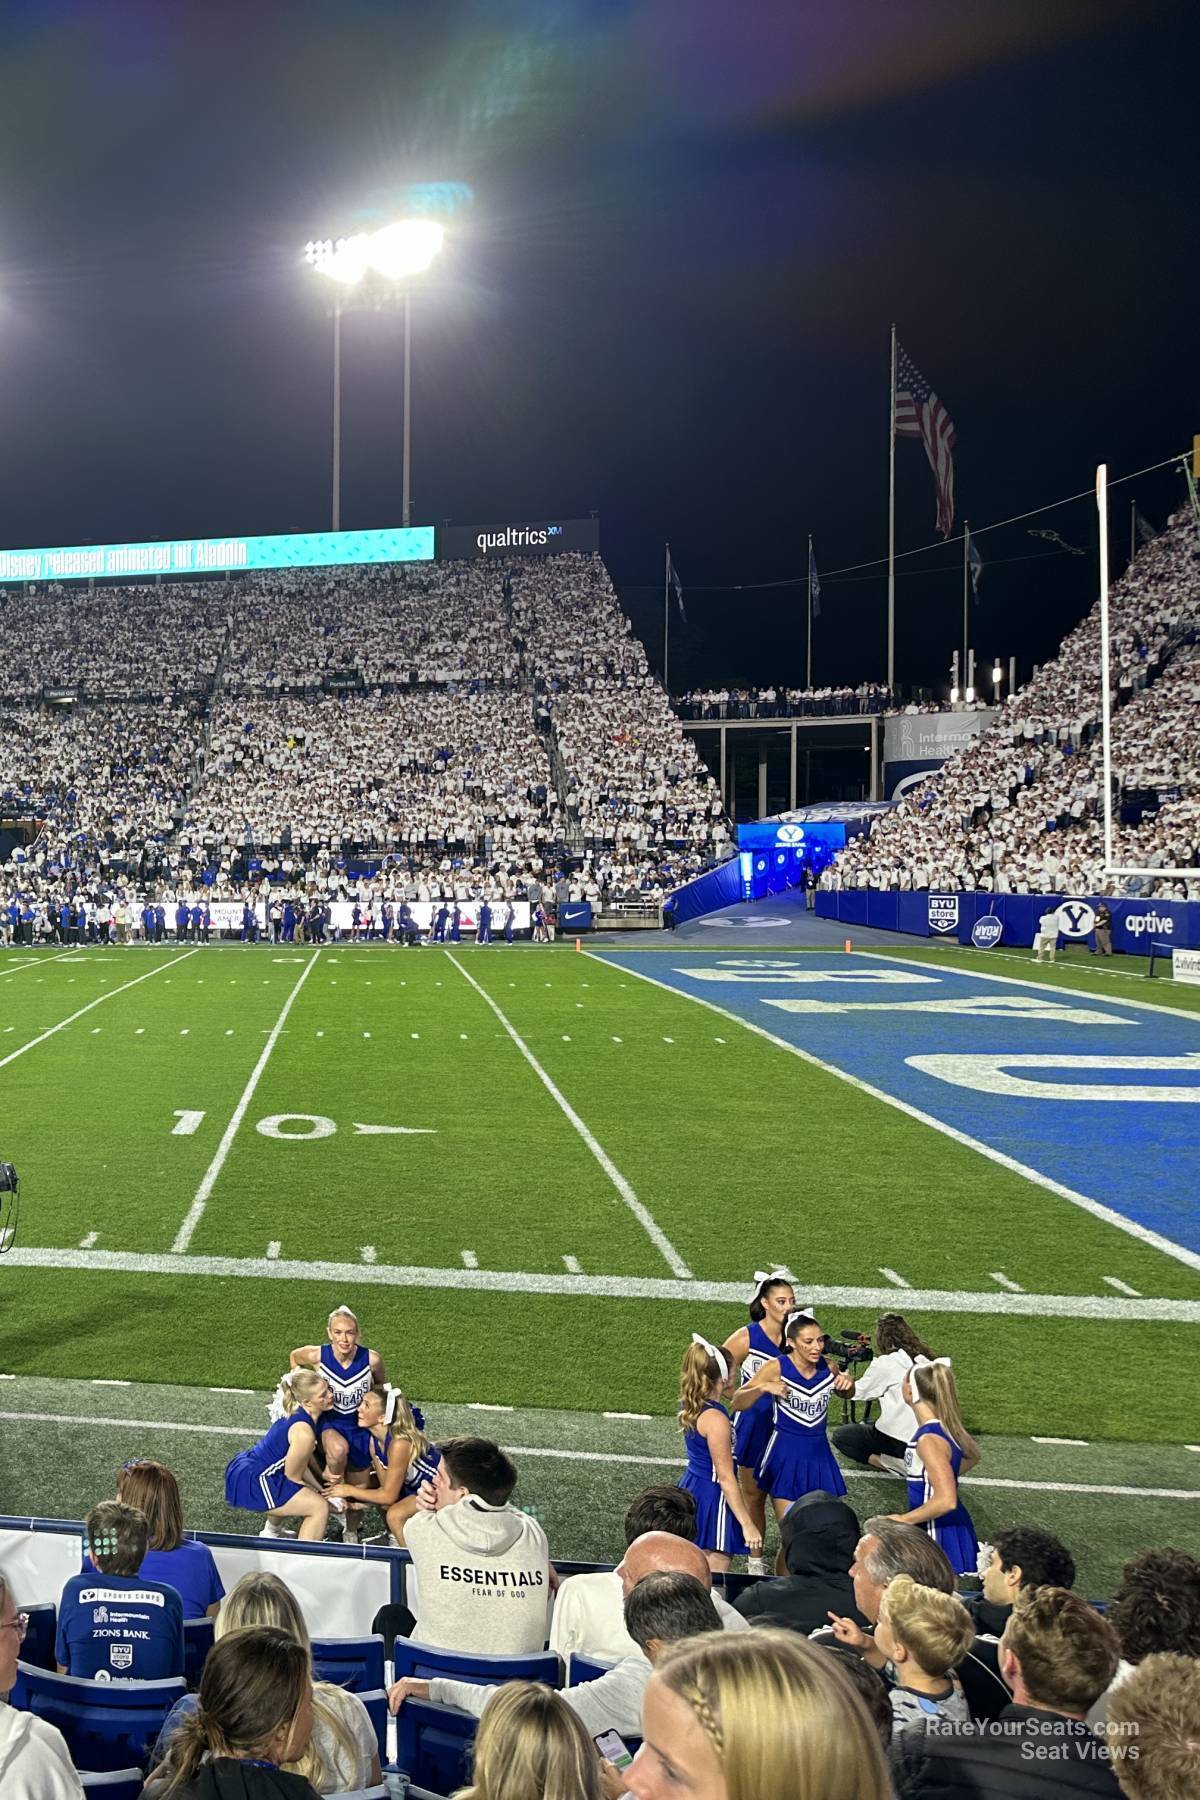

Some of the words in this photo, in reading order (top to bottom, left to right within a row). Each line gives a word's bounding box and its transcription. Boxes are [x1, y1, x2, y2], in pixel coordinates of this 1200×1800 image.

[477, 527, 547, 553] qualtrics
[0, 551, 41, 577] Disney
[108, 545, 171, 571] animated
[919, 733, 970, 743] Intermo
[931, 899, 954, 908] BYU
[931, 910, 954, 918] store
[1125, 910, 1173, 937] aptive
[975, 925, 999, 936] ROAR
[171, 1109, 338, 1140] 10
[440, 1565, 543, 1587] ESSENTIALS
[472, 1588, 492, 1596] FEAR
[511, 1591, 525, 1599] GOD
[92, 1629, 121, 1638] ZIONS
